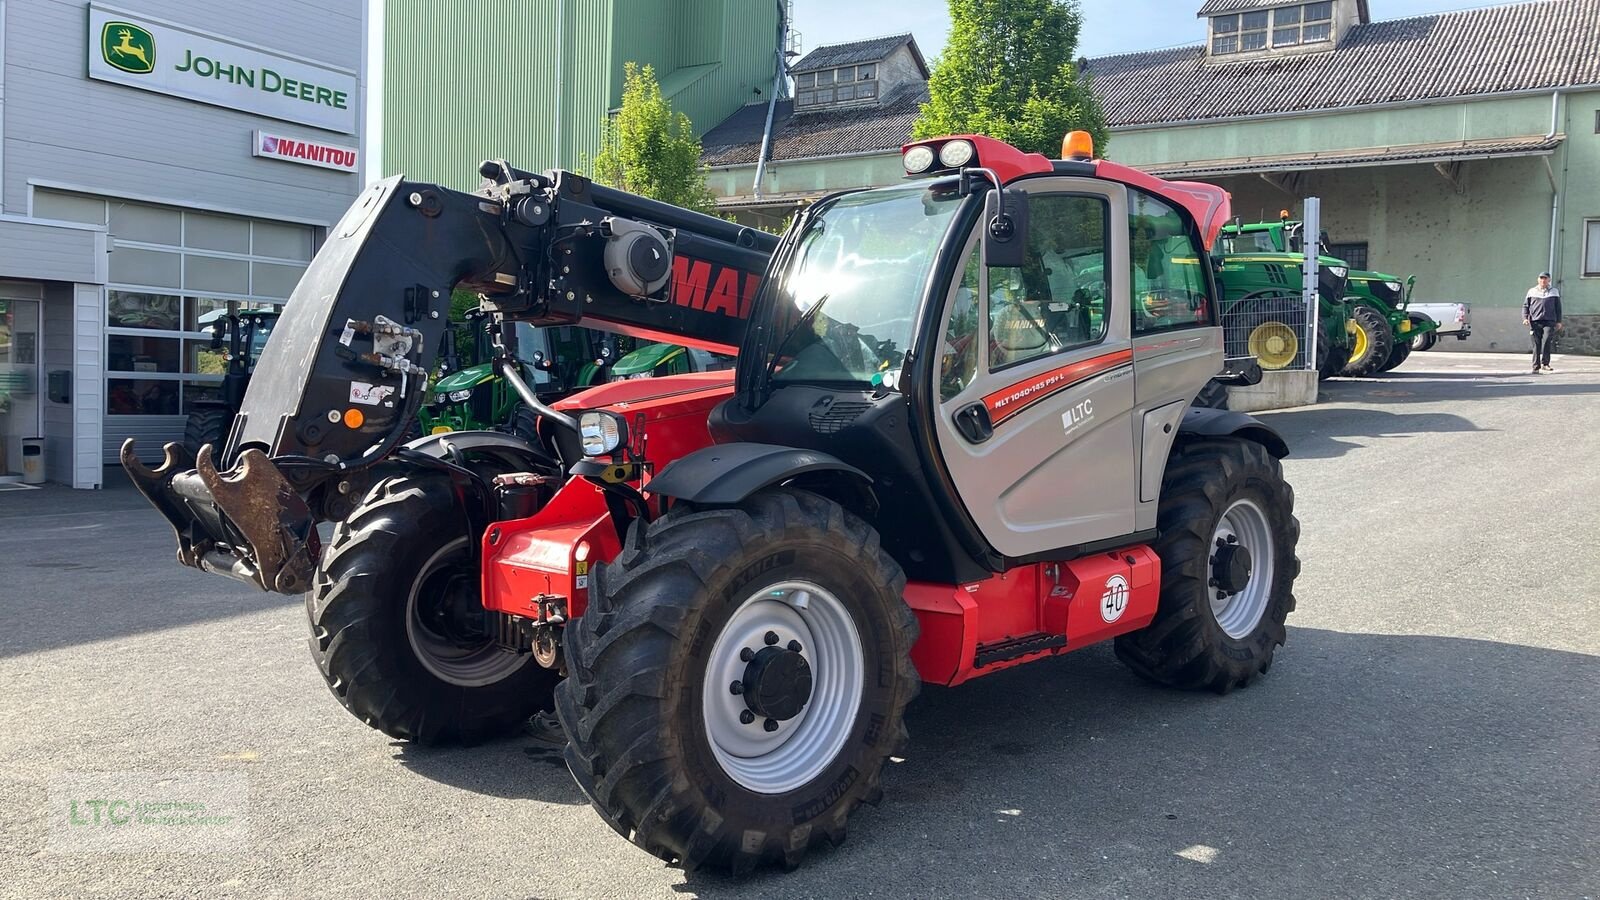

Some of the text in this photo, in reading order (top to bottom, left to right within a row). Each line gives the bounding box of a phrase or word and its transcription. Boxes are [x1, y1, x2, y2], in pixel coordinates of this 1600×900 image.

[175, 49, 348, 110] JOHN DEERE
[277, 139, 356, 168] MANITOU
[994, 397, 1011, 409] MLT
[1072, 399, 1093, 422] LTC
[1106, 583, 1124, 614] 40
